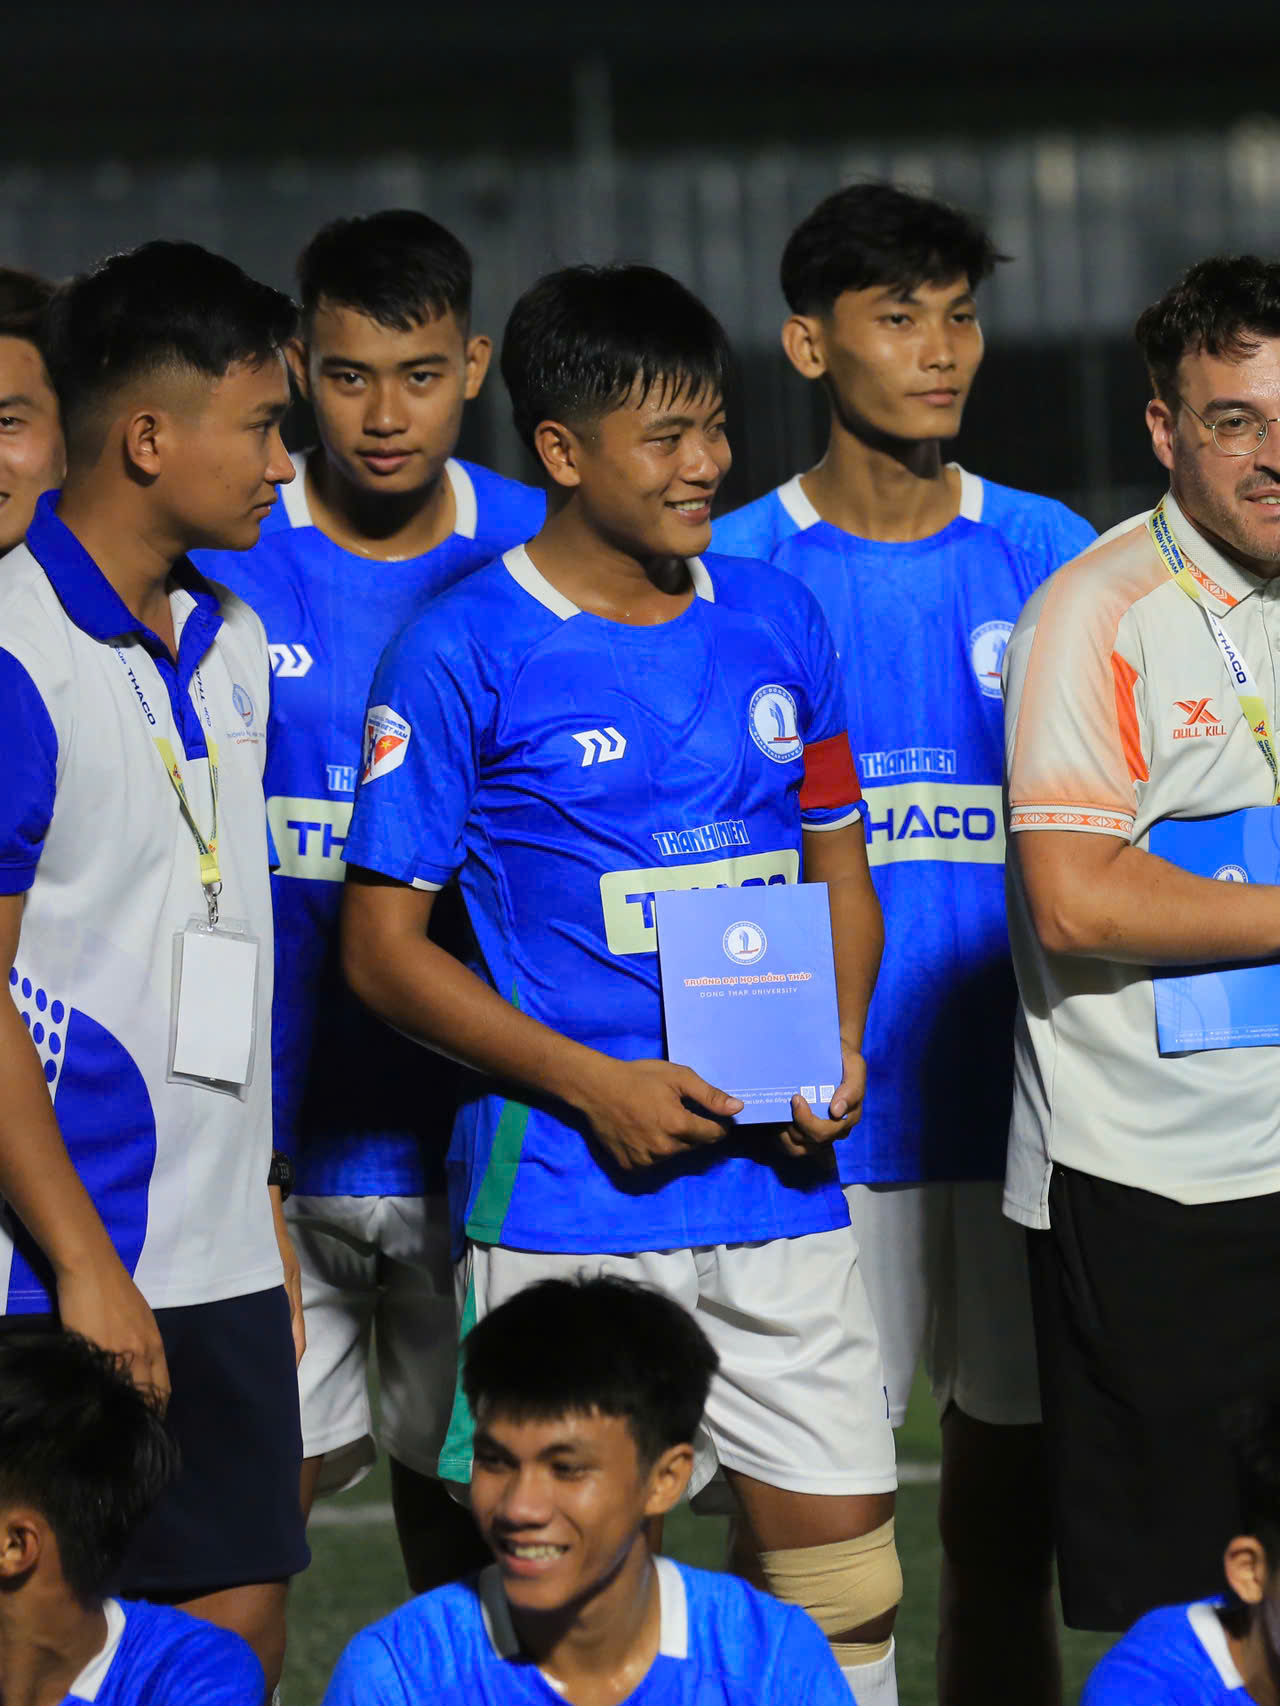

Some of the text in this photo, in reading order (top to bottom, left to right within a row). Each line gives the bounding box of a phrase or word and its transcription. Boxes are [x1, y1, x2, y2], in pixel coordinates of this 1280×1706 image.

[1168, 557, 1179, 574] NAM
[1218, 628, 1247, 684] THACO
[128, 667, 156, 725] THACO
[1205, 725, 1227, 737] KILL
[652, 823, 720, 856] THANH
[865, 804, 996, 844] HACO
[752, 987, 798, 995] UNIVERSITY
